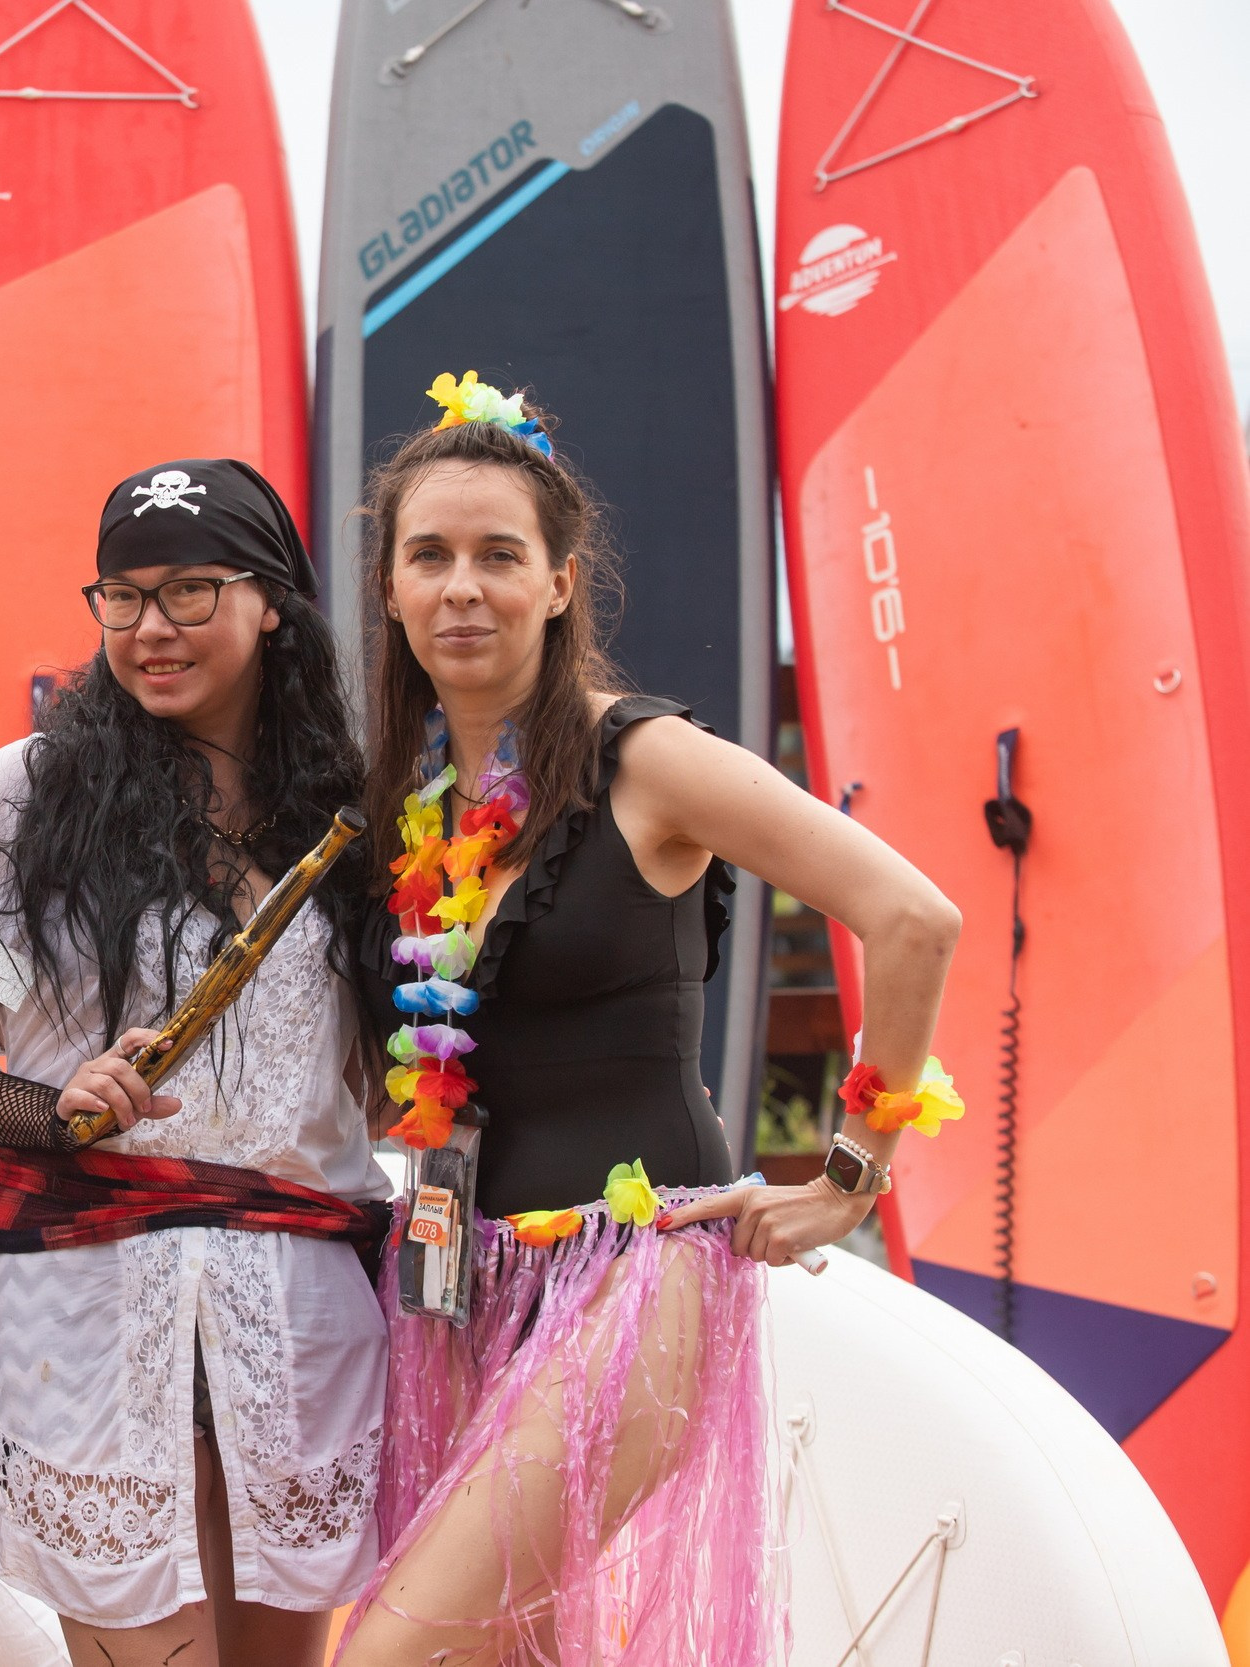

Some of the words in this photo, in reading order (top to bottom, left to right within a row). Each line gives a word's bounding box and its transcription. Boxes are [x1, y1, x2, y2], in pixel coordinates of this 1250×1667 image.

[790, 235, 883, 292] ADVENTUM
[418, 1203, 443, 1214] ЗАПЛЫВ
[416, 1221, 437, 1238] 078
